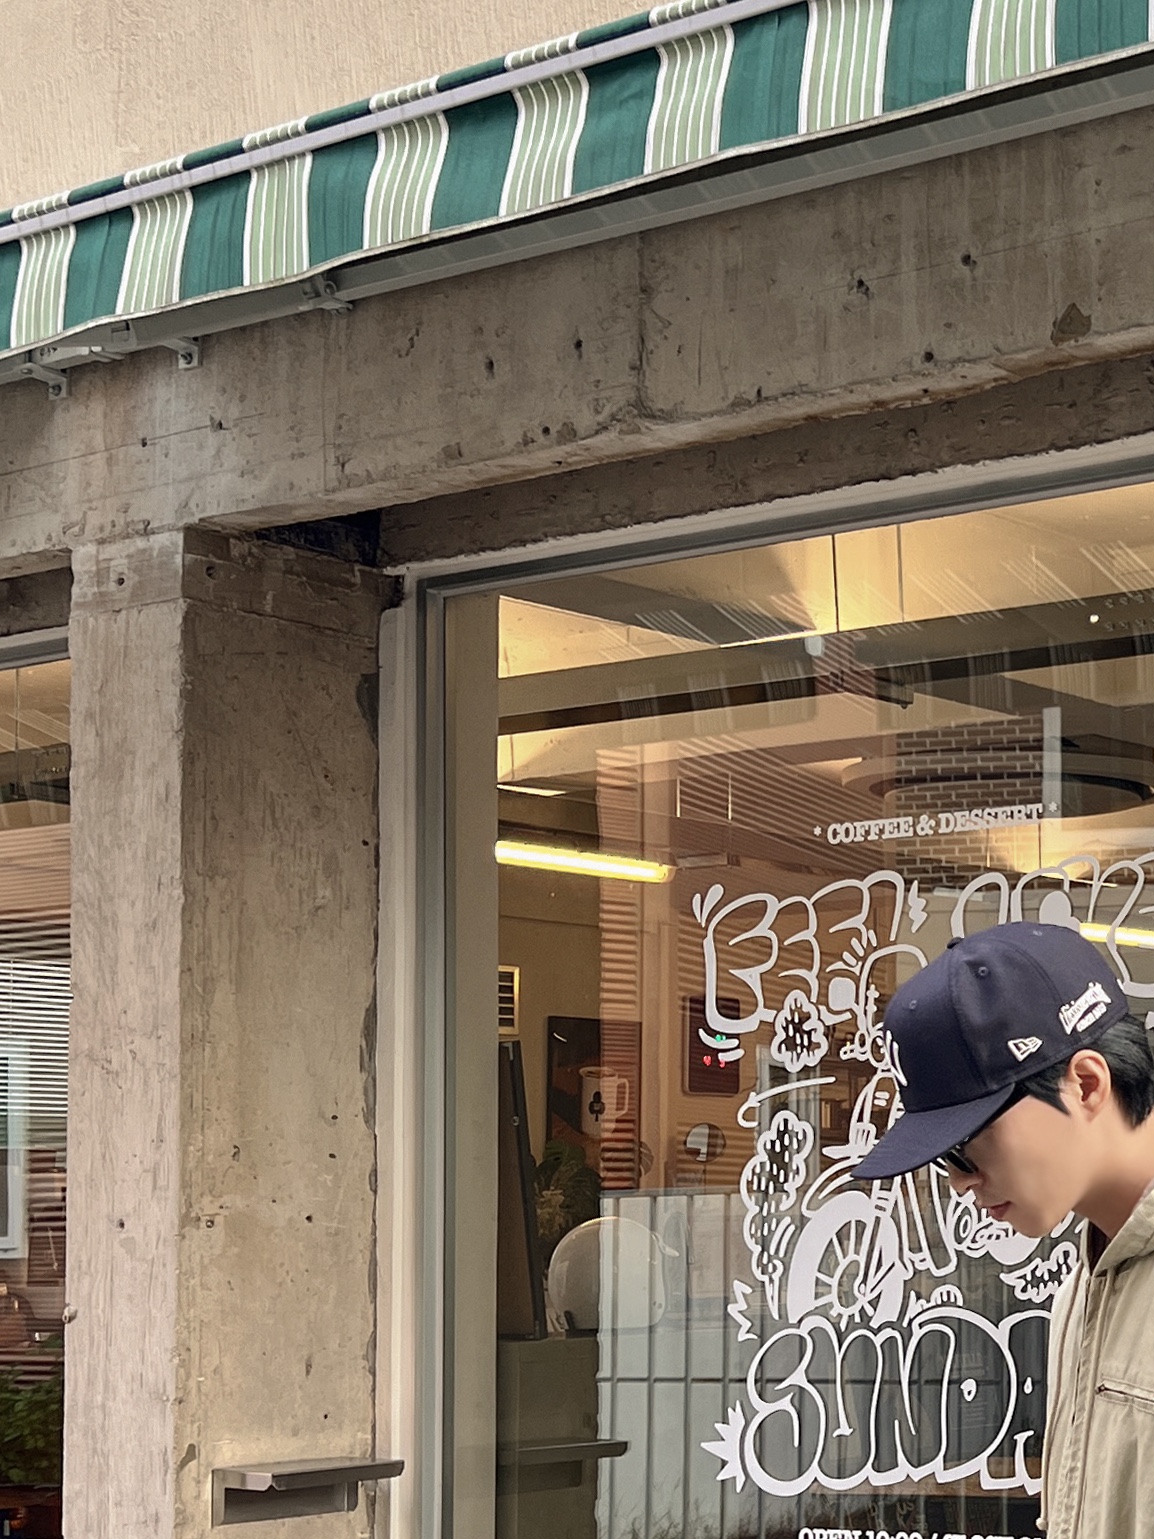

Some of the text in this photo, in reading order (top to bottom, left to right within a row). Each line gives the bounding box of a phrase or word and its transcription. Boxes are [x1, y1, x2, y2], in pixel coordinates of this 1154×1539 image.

[827, 803, 1043, 845] COFFEE & DESSERT
[744, 1305, 1052, 1497] SUNDA
